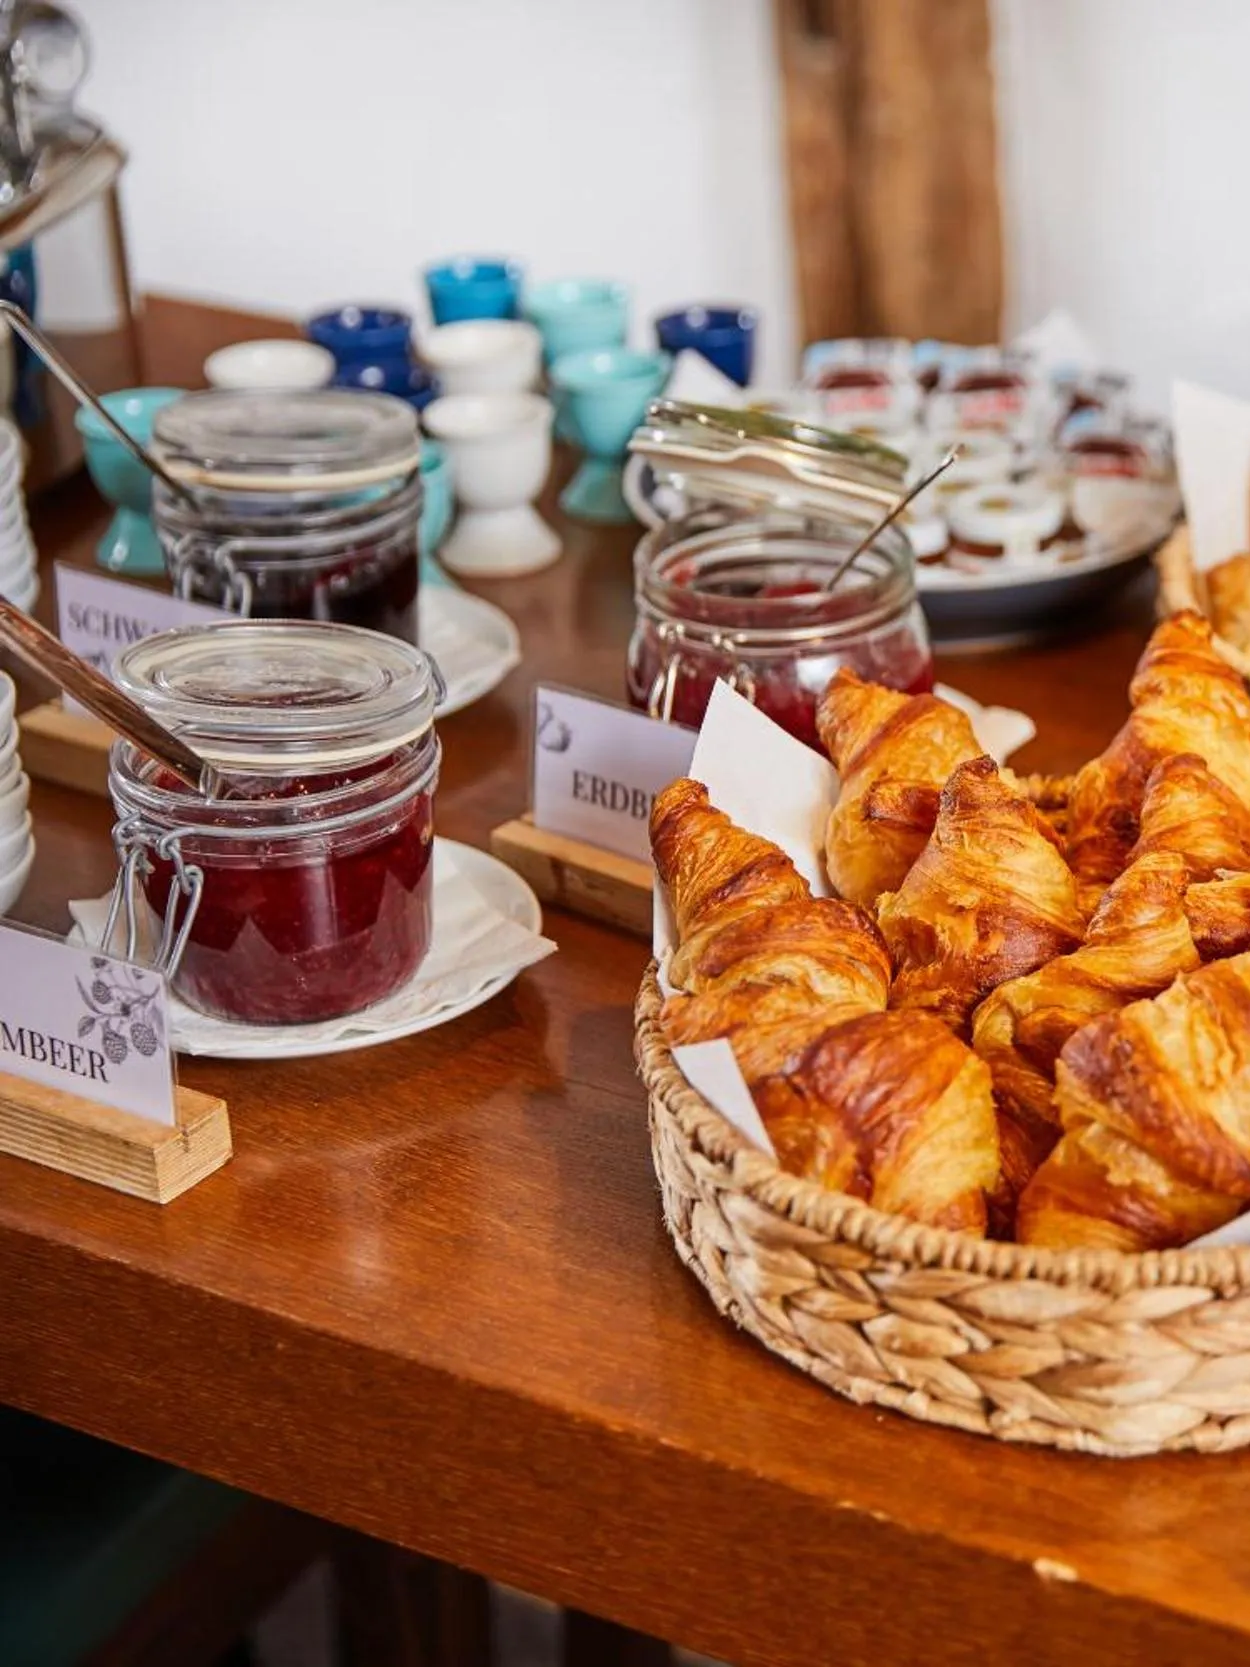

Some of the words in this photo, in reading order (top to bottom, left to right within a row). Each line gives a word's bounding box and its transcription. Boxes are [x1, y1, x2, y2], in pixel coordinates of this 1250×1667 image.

[67, 601, 159, 644] SCHW
[571, 769, 657, 821] ERDB
[0, 1020, 110, 1083] MBEER
